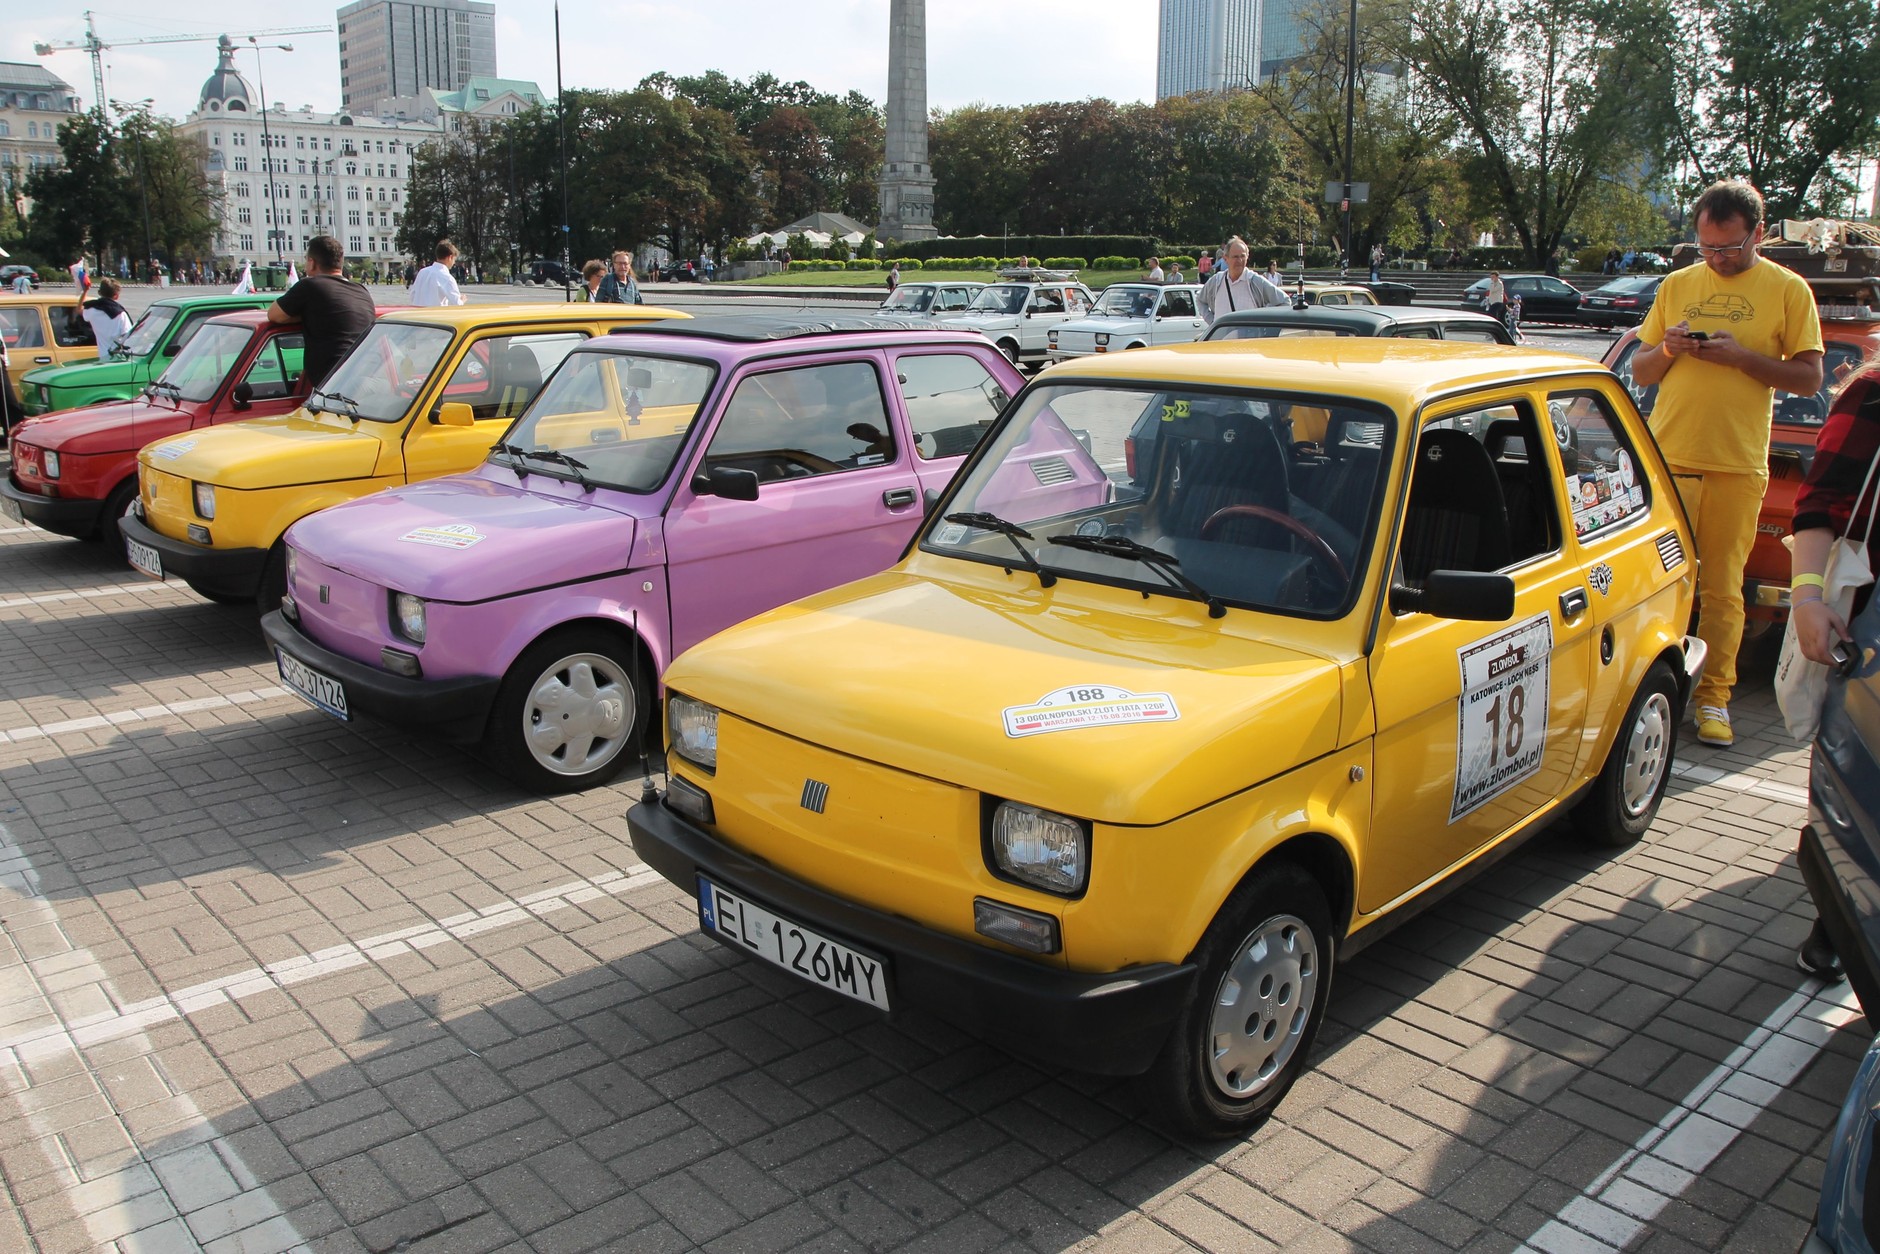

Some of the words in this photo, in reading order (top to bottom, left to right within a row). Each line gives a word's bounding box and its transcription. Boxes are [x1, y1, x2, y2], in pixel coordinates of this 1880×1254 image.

[1758, 524, 1784, 537] 26p
[304, 669, 345, 711] 37126
[1066, 688, 1105, 703] 188
[1470, 683, 1503, 704] KATOWICE
[1507, 671, 1524, 686] LOCH
[1524, 664, 1539, 679] NESS
[1027, 708, 1092, 723] OGÓLNOPOLSKI
[1094, 706, 1114, 715] ZLOT
[1116, 704, 1141, 713] FIATA
[1144, 702, 1165, 710] 126P
[1044, 717, 1085, 727] WARSZAWA
[1485, 684, 1525, 768] 18
[1460, 748, 1539, 802] www.zlombol.pl
[703, 907, 713, 922] PL
[716, 890, 758, 950] EL
[772, 920, 876, 1001] 126MY
